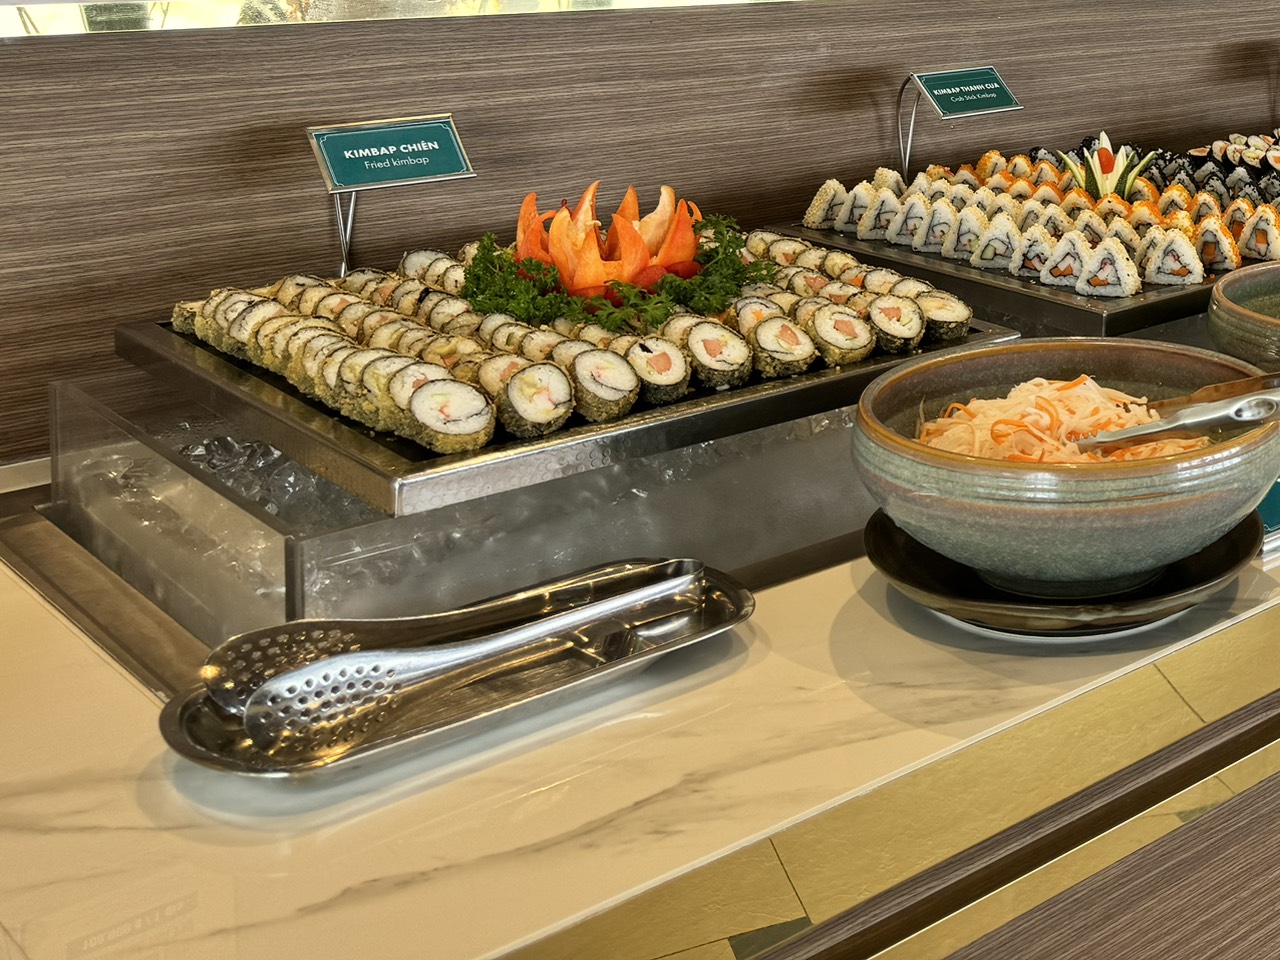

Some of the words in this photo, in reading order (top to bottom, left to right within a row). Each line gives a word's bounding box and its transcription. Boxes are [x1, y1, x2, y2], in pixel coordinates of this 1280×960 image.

[933, 86, 960, 96] KIMBAP
[960, 84, 985, 93] THANH
[986, 82, 1000, 90] CUA
[344, 146, 397, 160] KIMBAP
[399, 140, 440, 153] CHIÊN
[365, 158, 391, 170] Fried
[392, 155, 430, 167] kimbap
